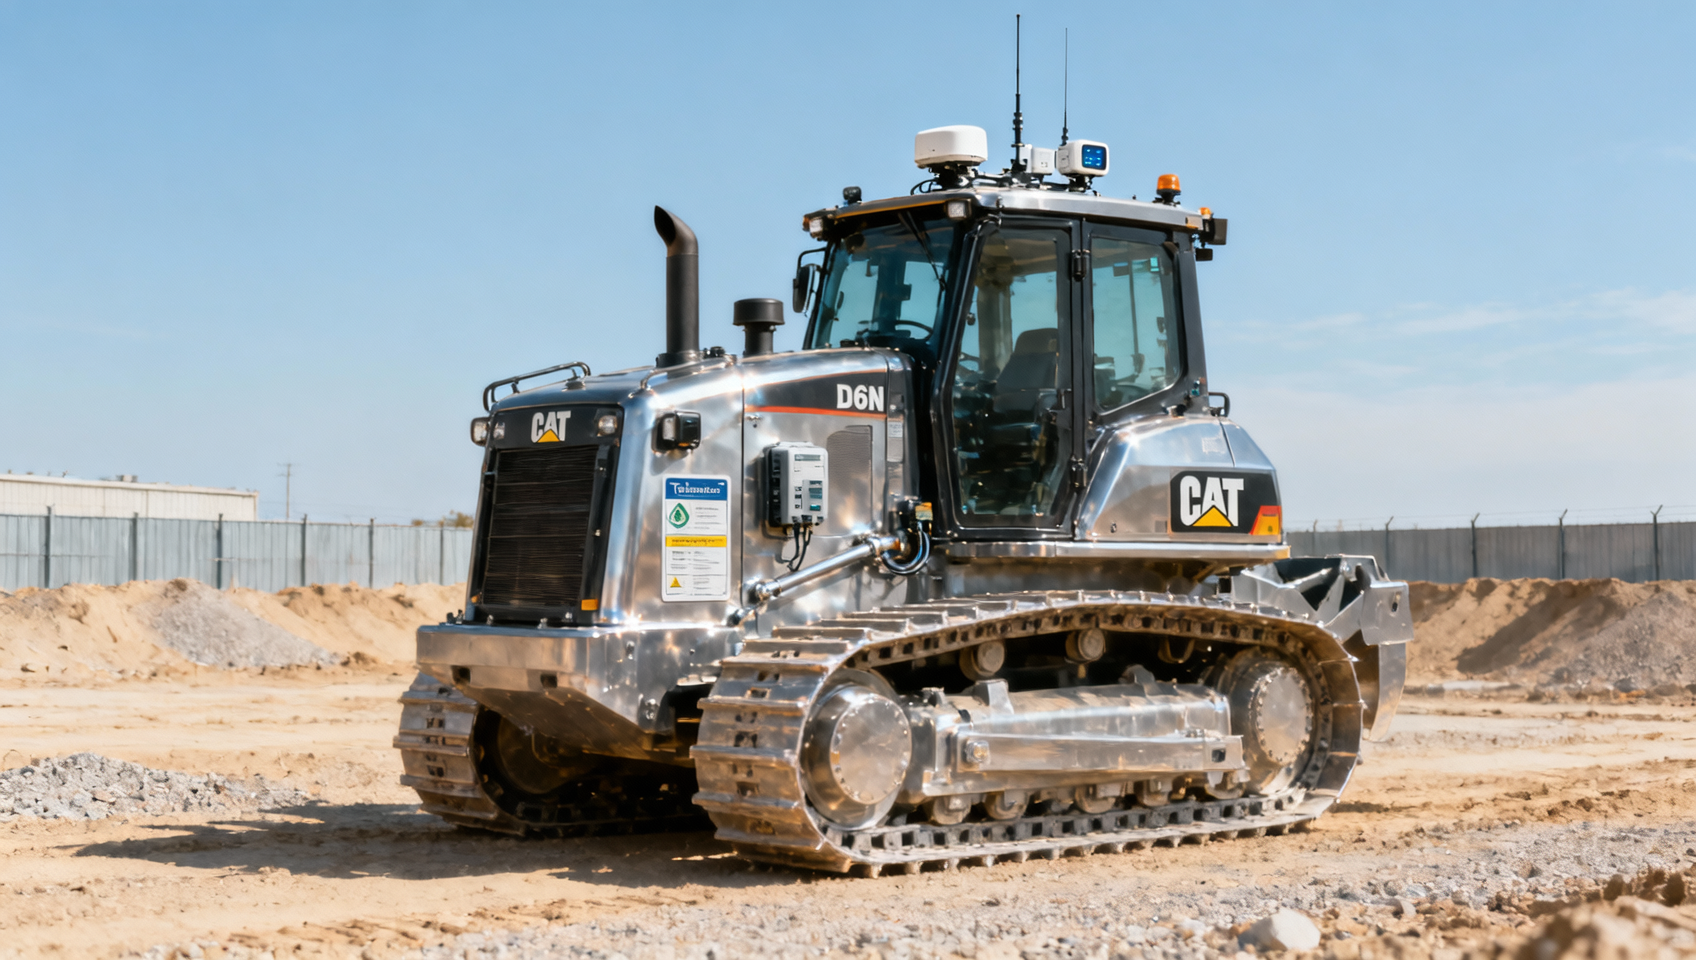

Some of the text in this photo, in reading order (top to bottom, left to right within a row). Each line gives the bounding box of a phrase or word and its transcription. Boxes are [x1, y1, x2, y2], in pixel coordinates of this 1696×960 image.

[837, 384, 884, 412] D6N
[531, 410, 571, 443] CAT
[1180, 475, 1244, 527] CAT
